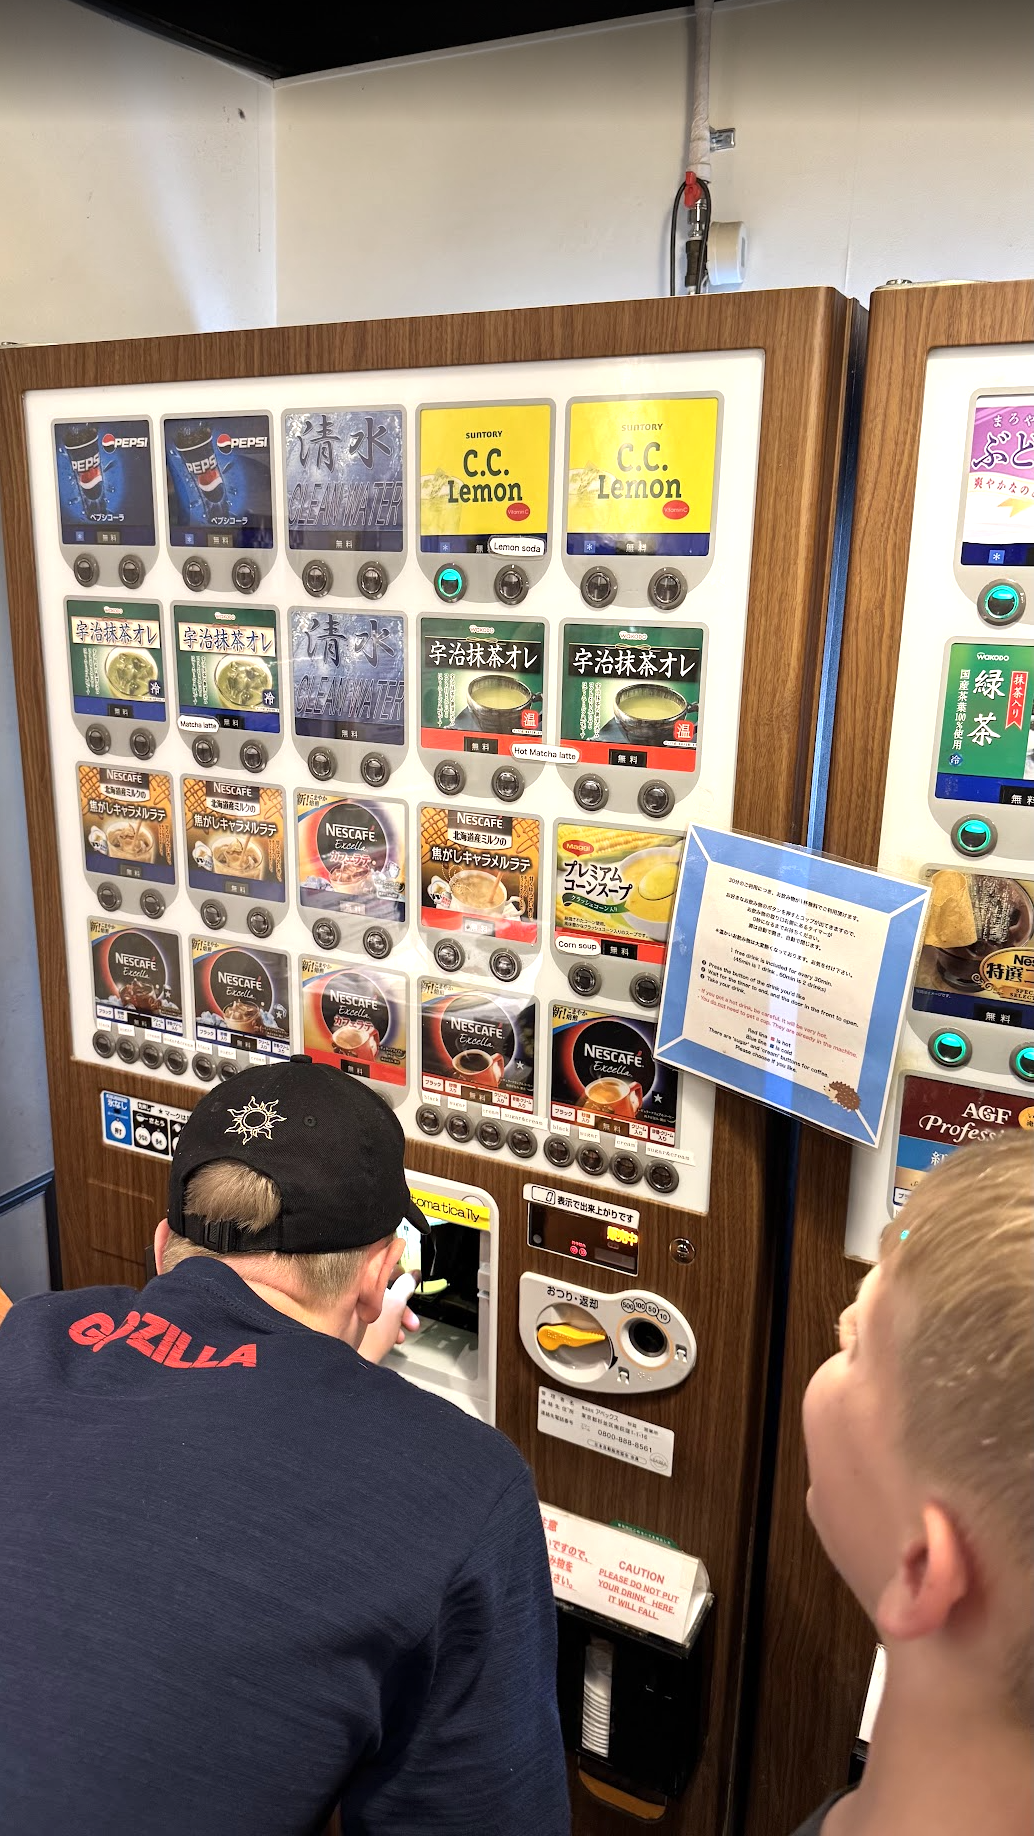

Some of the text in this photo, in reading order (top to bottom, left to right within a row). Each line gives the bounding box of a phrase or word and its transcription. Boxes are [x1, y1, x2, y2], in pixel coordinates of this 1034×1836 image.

[466, 430, 502, 439] SUNTORY
[621, 423, 663, 431] SUNTORY
[114, 437, 148, 448] PEPSI
[230, 437, 268, 448] PEPSI
[297, 415, 392, 473] 清水
[72, 454, 99, 471] PEPS
[186, 454, 217, 473] PEPS
[463, 448, 510, 477] C.C.
[617, 442, 668, 472] C.C.
[448, 480, 522, 503] Lemon
[598, 475, 682, 499] Lemon
[974, 477, 1034, 498] 爽やかなの
[211, 517, 248, 525] ペプシコーラ
[494, 542, 541, 553] Lemon soda
[76, 620, 158, 645] 宇治抹茶オレ
[183, 626, 273, 654] 宇治抹茶オレ
[305, 614, 395, 668] 清水
[429, 641, 538, 670] 宇治抹茶オレ
[573, 648, 696, 678] 宇治抹茶オレ
[150, 682, 160, 695] 冷
[1012, 675, 1024, 718] 抹茶入り
[264, 691, 275, 705] 冷
[952, 669, 971, 750] 国産茶葉100%使用
[967, 670, 1006, 746] 緑茶
[524, 713, 536, 727] 温
[677, 723, 691, 738] 温
[471, 743, 490, 751] 無料
[514, 747, 576, 760] Hot Matcha latte
[618, 754, 638, 764] 無料
[950, 755, 961, 765] 冷
[104, 785, 146, 799] 北海道産ミルクの
[89, 800, 166, 822] 焦がしキャラメルラテ
[211, 799, 256, 814] 北海道産ミルクの
[194, 814, 277, 837] 焦がしキャラメルラテ
[457, 812, 503, 828] NESCAFÉ
[325, 823, 376, 842] NESCAFÉ
[453, 831, 507, 846] 北海道産ミルクの
[335, 840, 366, 850] Excella
[330, 851, 372, 865] カフェラテ
[432, 846, 530, 872] 焦がしキャラメルラテ
[564, 860, 622, 883] プレミアム
[564, 878, 633, 900] コーンスープ
[571, 894, 618, 912] クラッシュコーン入り
[610, 946, 629, 956] 無料
[115, 952, 156, 971] NESCAFÉ
[765, 960, 787, 971] included
[123, 967, 150, 979] Excella
[218, 971, 262, 990] NESCAFÉ
[708, 962, 722, 970] Press
[766, 983, 779, 991] drink
[226, 987, 255, 999] Excella
[330, 990, 378, 1010] NESCAFÉ
[339, 1006, 370, 1019] Excella
[820, 1010, 834, 1018] front
[985, 1012, 1011, 1024] 無料
[334, 1015, 373, 1031] カフェラテ
[450, 1017, 503, 1039] NESCAFÉ
[772, 1022, 784, 1031] They
[795, 1031, 815, 1042] already
[459, 1034, 493, 1048] Excella
[708, 1027, 722, 1036] There
[780, 1055, 800, 1066] buttons
[584, 1043, 642, 1067] NESCAFÉ
[735, 1044, 751, 1054] Please
[752, 1051, 770, 1062] choose
[594, 1060, 631, 1077] Excella
[148, 1116, 165, 1127] さとう
[961, 1102, 1012, 1125] AGF
[602, 1123, 621, 1132] 無料
[631, 1124, 646, 1132] クリーム
[919, 1114, 1004, 1142] Profess
[410, 1194, 480, 1223] tomatically
[557, 1195, 634, 1223] 表示で出来上がりです
[547, 1286, 599, 1310] おつり・返却
[622, 1301, 633, 1310] 500
[635, 1302, 645, 1310] 100
[648, 1306, 657, 1314] 50
[597, 1428, 651, 1453] 0800-888-8561
[618, 1559, 664, 1584] CAUTION
[598, 1567, 679, 1604] PLEASE DO NOT PUT
[598, 1578, 675, 1614] YOUR DRINK HERE.
[608, 1594, 615, 1604] IT
[618, 1598, 635, 1611] WILL
